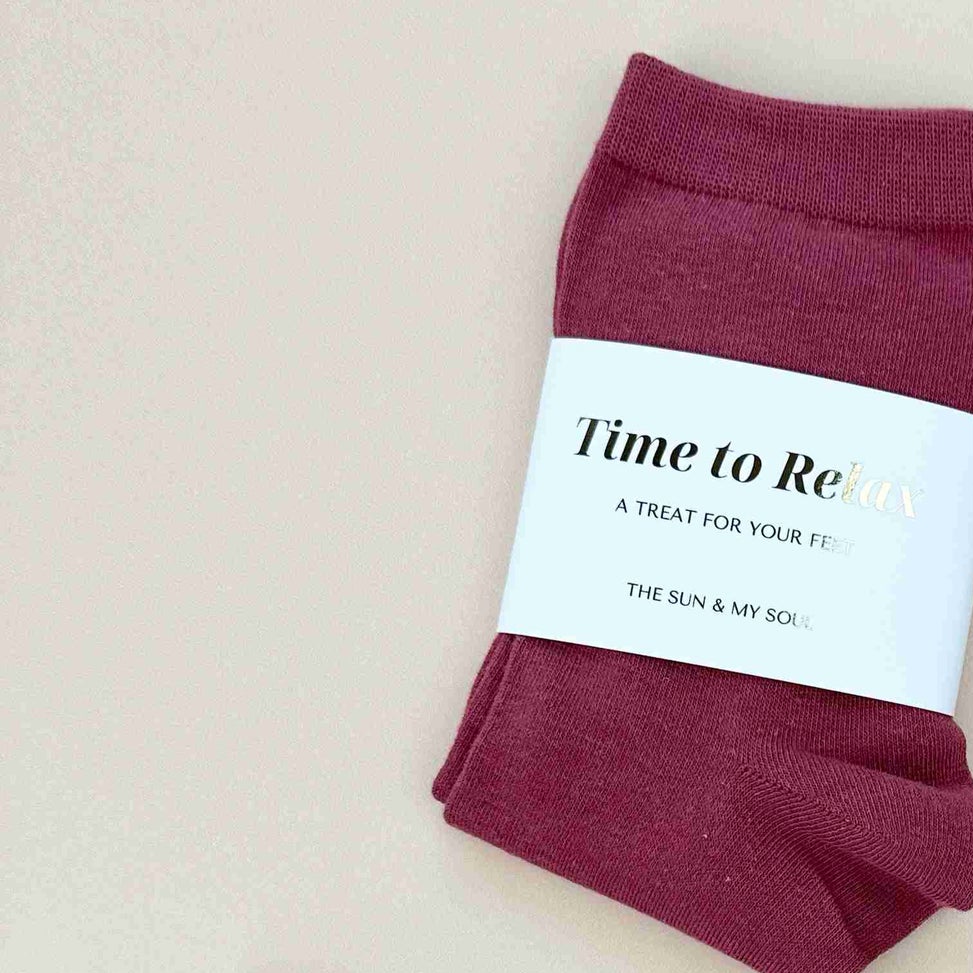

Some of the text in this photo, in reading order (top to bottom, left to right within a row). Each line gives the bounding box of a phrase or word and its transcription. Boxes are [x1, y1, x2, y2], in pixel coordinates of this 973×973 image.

[575, 416, 925, 518] Time to Relax
[616, 498, 627, 513] A
[636, 501, 698, 524] TREAT
[704, 512, 741, 534] FOR
[749, 521, 802, 546] YOUR
[627, 582, 663, 603] THE
[668, 590, 706, 609] SUN
[713, 599, 725, 613] &
[731, 601, 761, 620] MY
